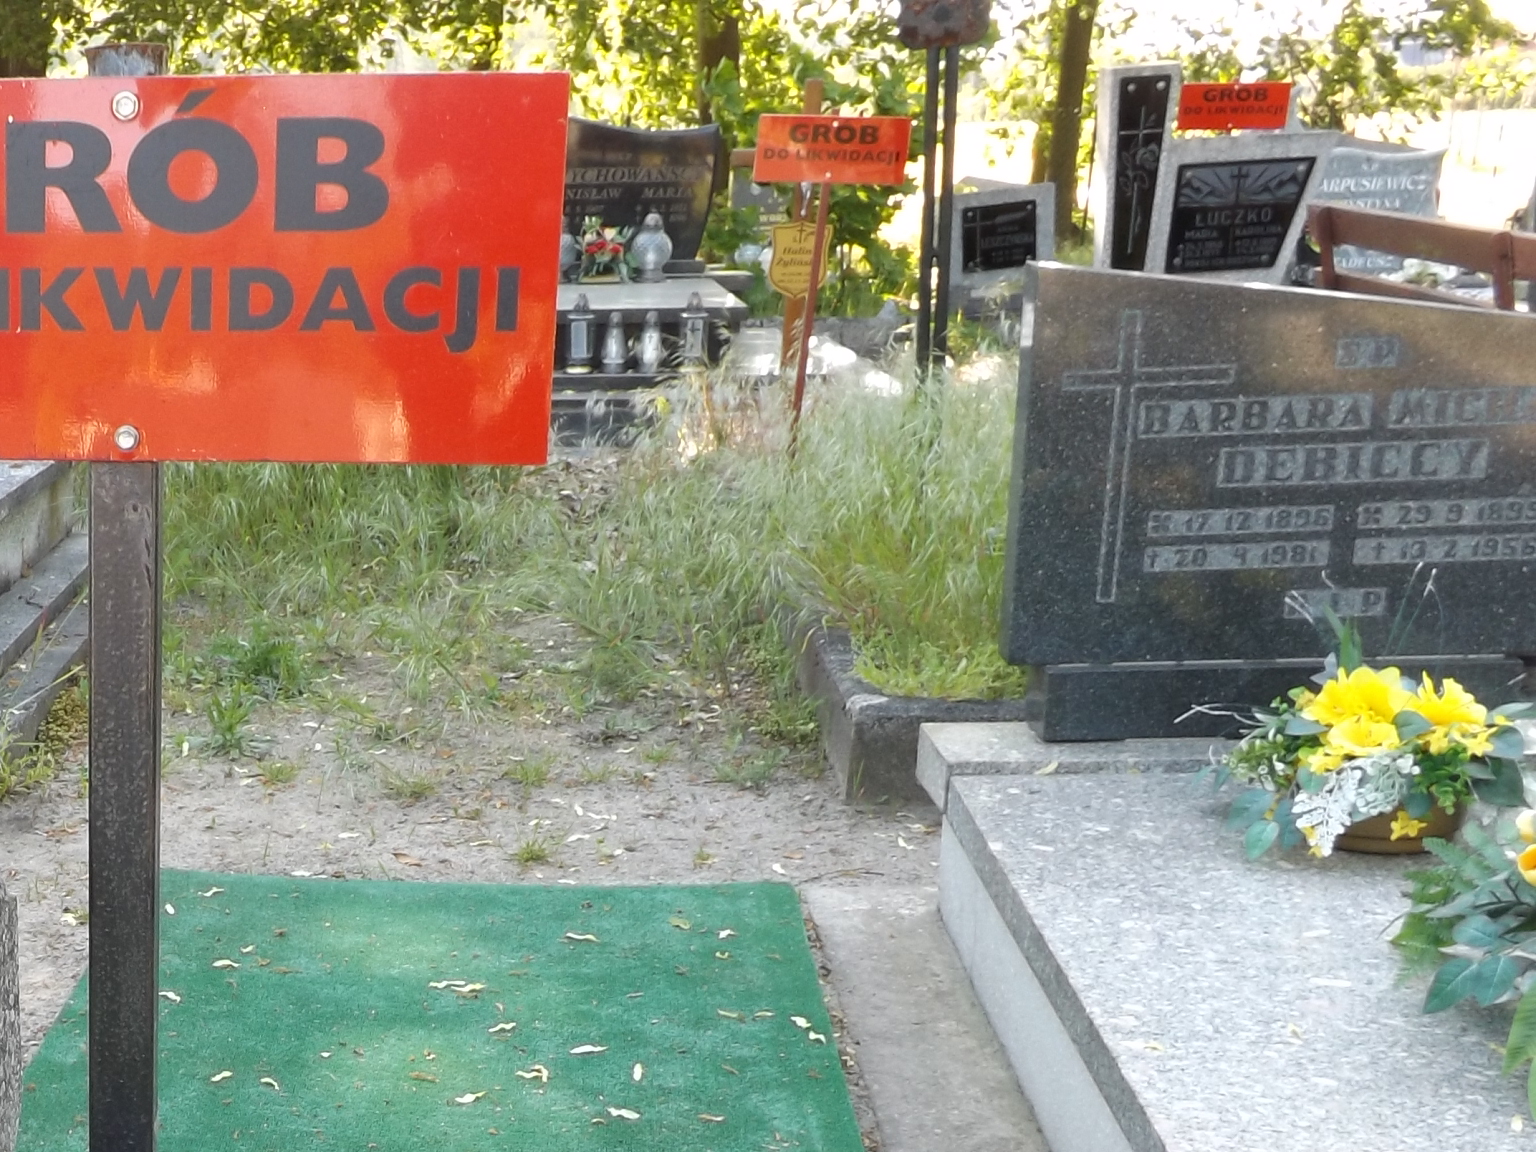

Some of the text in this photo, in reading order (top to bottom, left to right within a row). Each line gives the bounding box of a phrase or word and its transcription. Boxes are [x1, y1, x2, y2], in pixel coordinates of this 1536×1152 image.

[1202, 86, 1269, 102] GRÓB
[1184, 105, 1284, 115] DO LIKWIDACJI
[788, 121, 880, 145] GRÓB
[763, 148, 900, 165] DO LIKWIDACJI
[1318, 174, 1427, 194] ARPUSIEWICZ
[565, 187, 622, 199] NISŁAW
[1140, 397, 1367, 437] BARBARA
